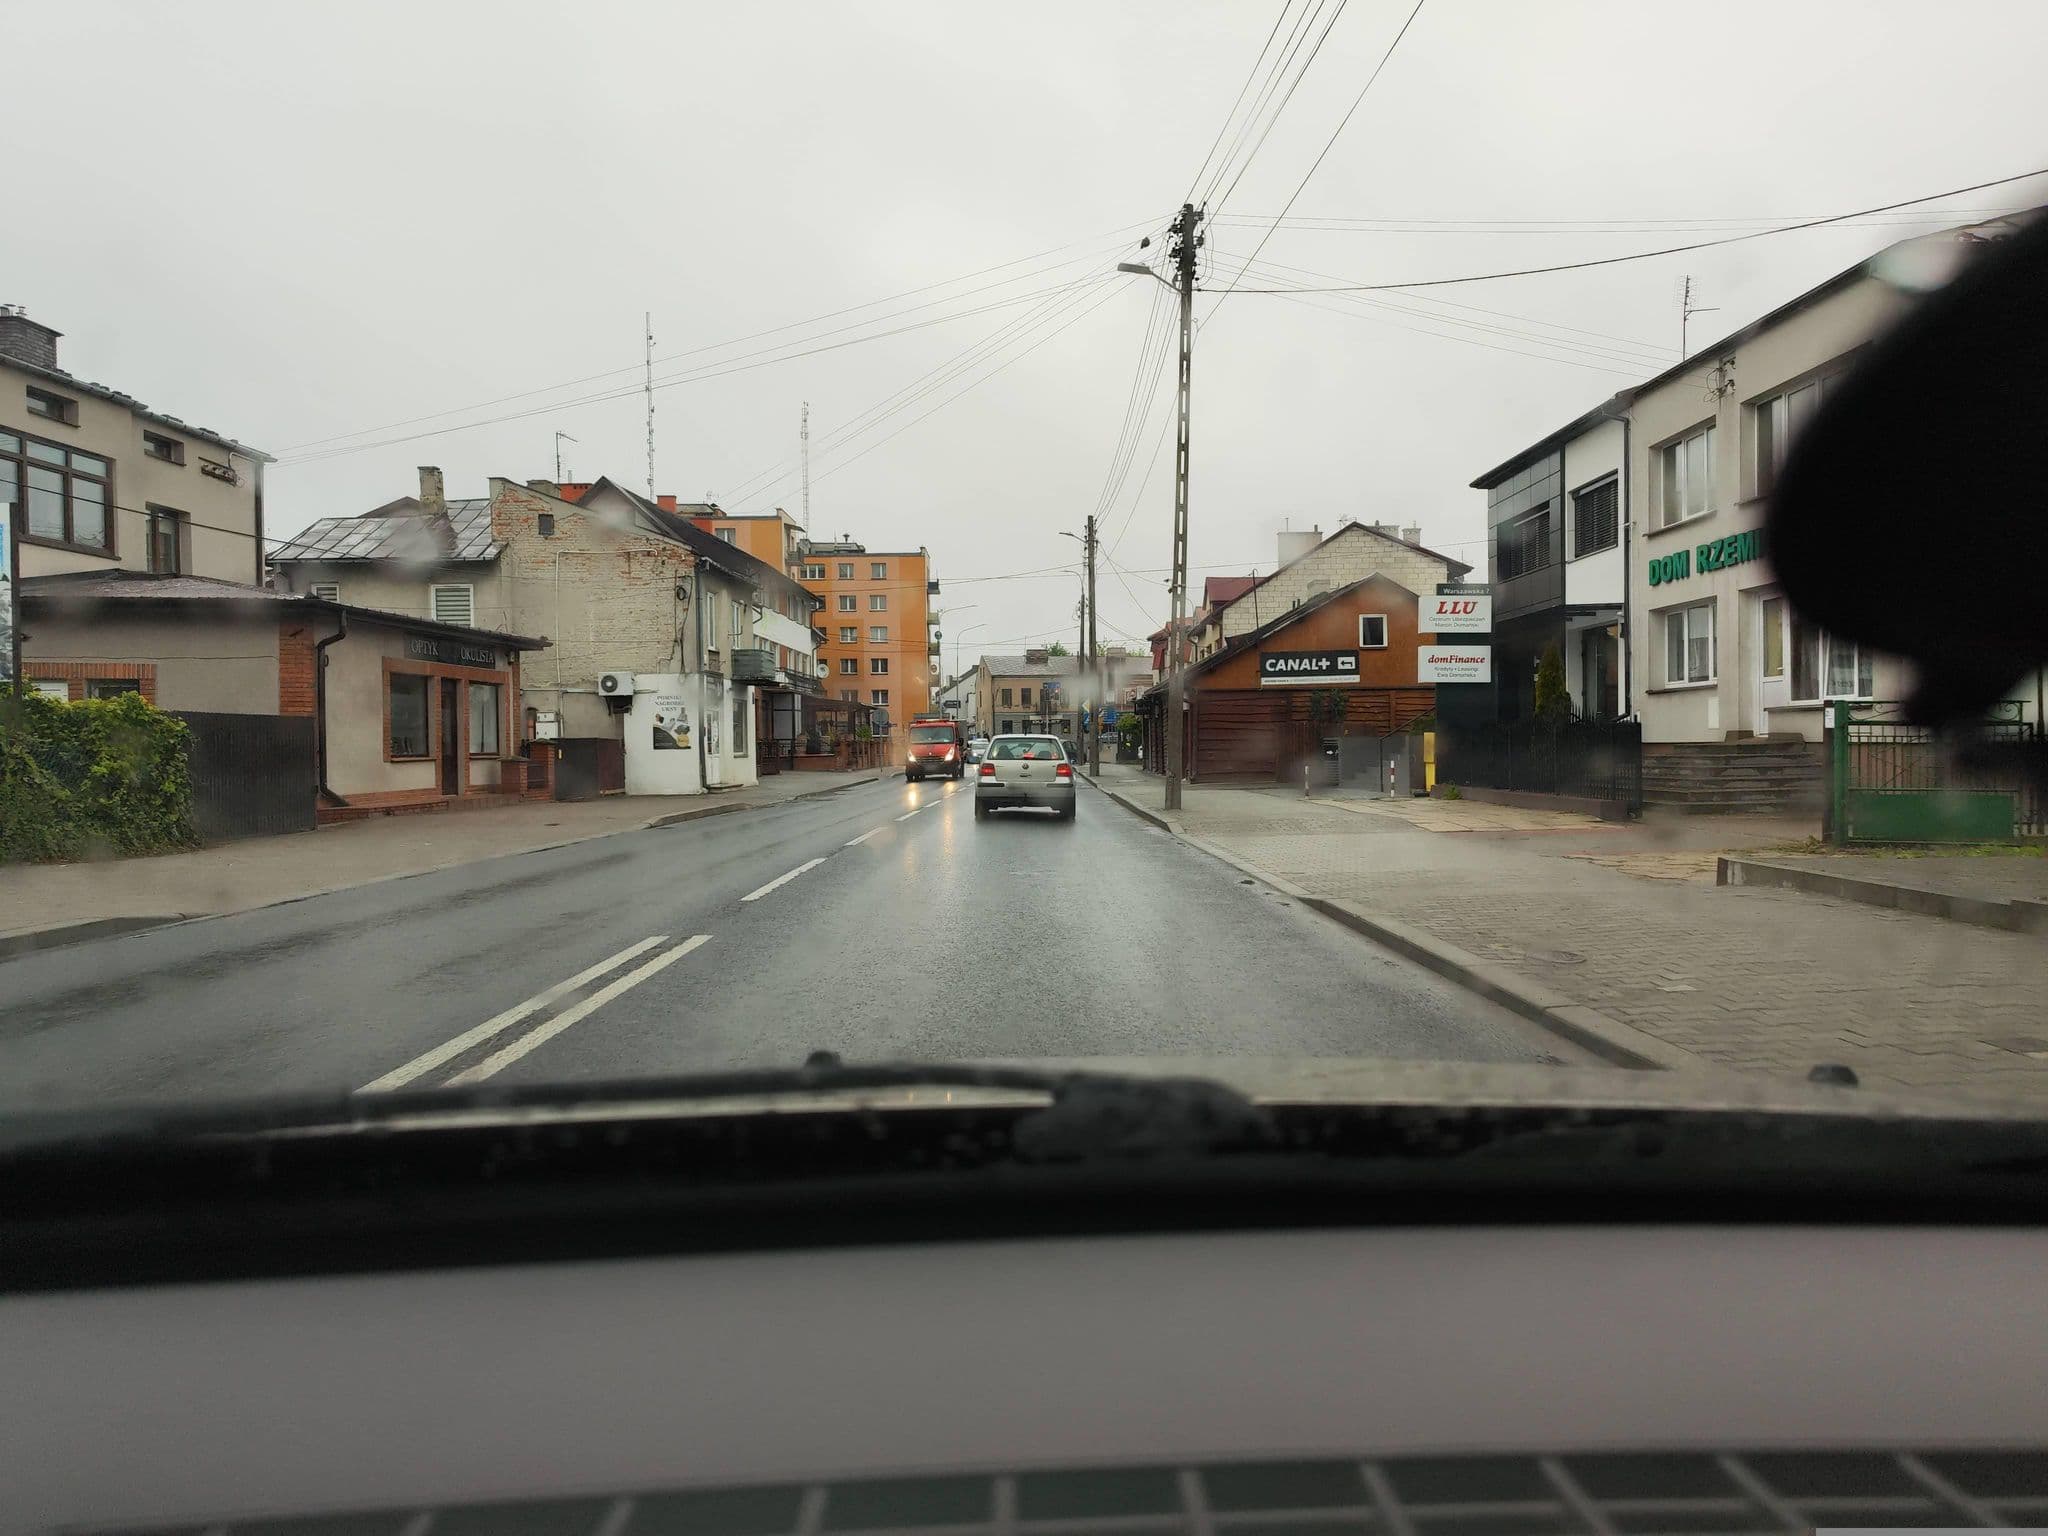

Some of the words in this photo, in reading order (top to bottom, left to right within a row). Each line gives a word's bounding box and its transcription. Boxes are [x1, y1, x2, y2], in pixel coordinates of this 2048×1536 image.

[1649, 550, 1690, 586] DOM
[1696, 528, 1765, 575] RZEMI
[1436, 601, 1478, 614] LLU
[411, 640, 439, 656] OPTYK
[460, 647, 495, 663] OKULISTA
[1265, 658, 1331, 672] CANAL+
[1428, 655, 1485, 664] domFinance
